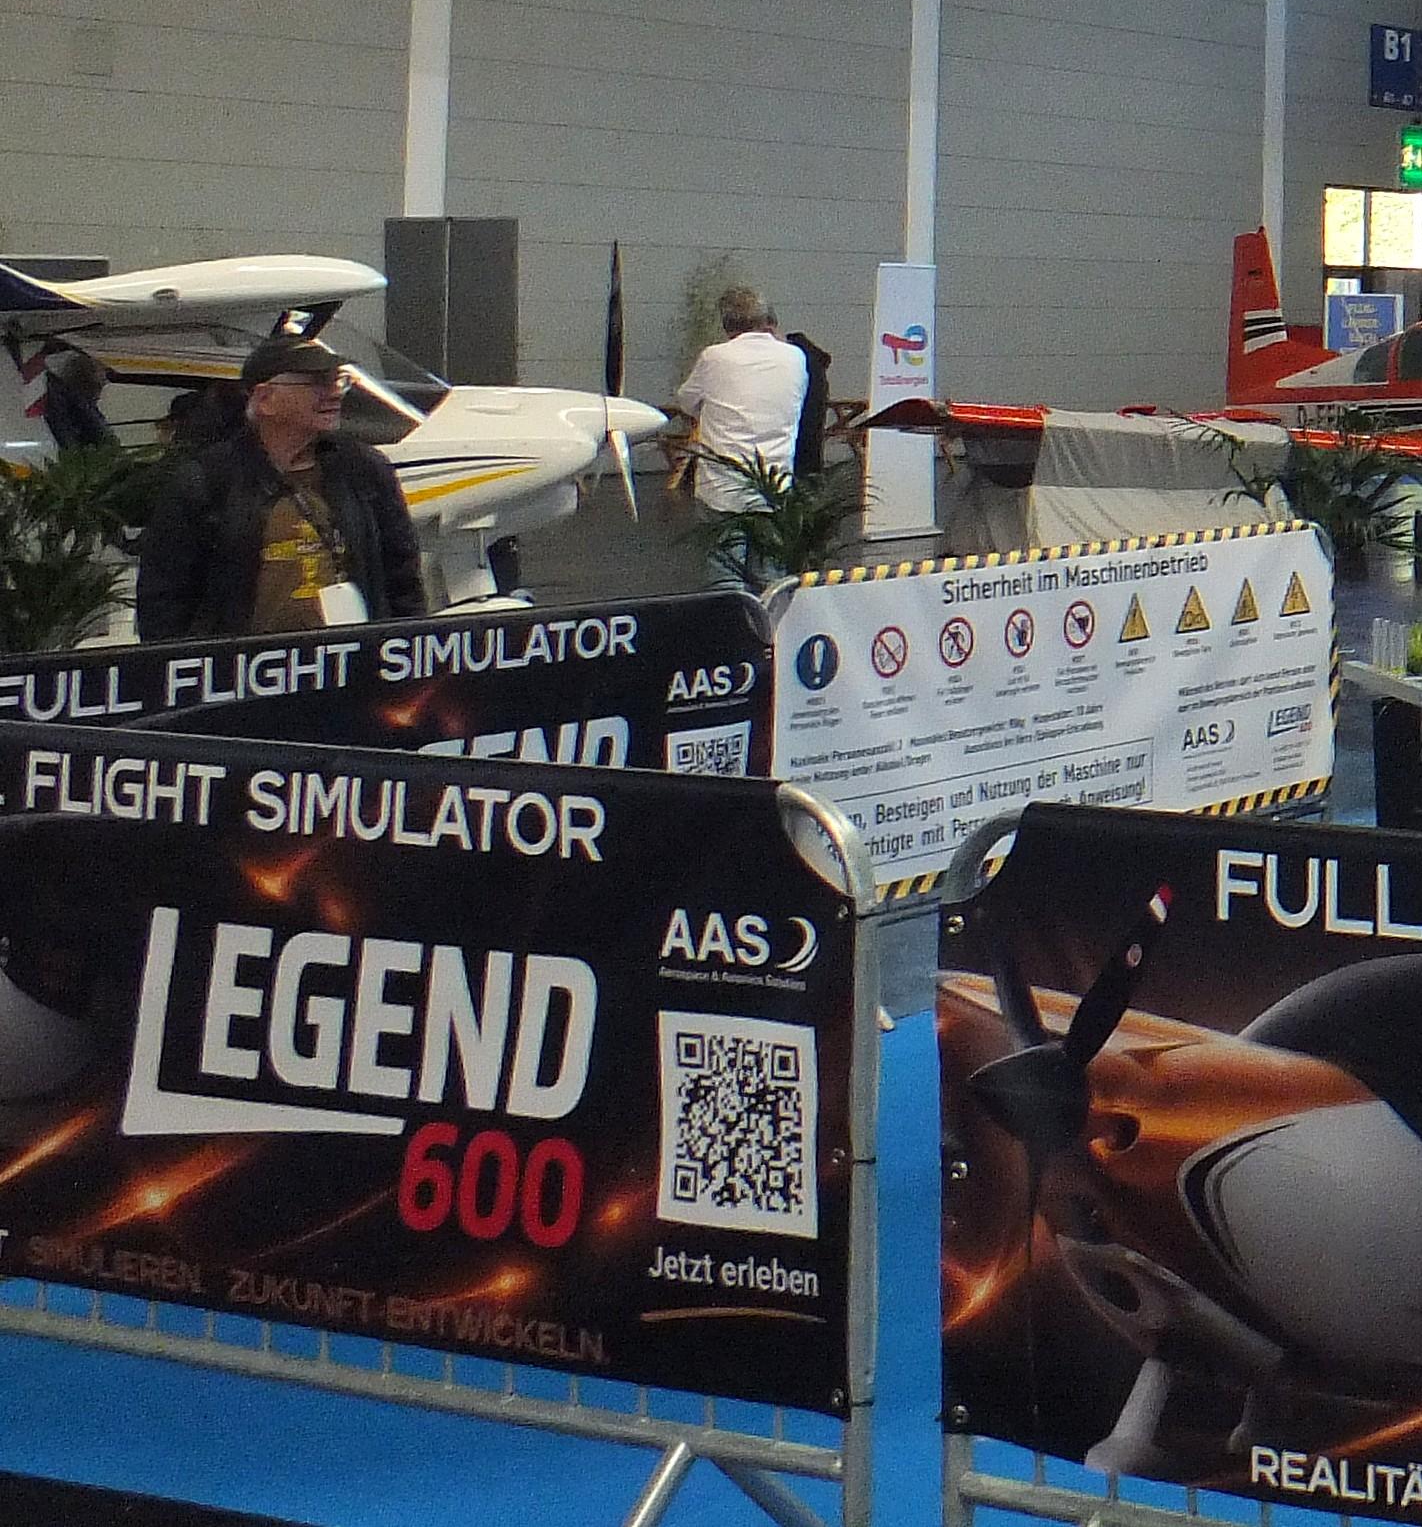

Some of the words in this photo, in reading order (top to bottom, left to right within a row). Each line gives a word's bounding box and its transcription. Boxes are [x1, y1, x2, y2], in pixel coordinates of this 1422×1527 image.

[1384, 29, 1411, 63] B1
[943, 573, 1033, 605] Sicherheit
[1039, 569, 1059, 593] im
[1066, 551, 1209, 588] Maschinenbetrieb
[166, 642, 360, 707] FLIGHT
[380, 614, 637, 681] SIMULATOR
[667, 665, 732, 702] AAS
[1182, 723, 1220, 751] AAS
[25, 750, 226, 826] FLIGHT
[246, 770, 605, 862] SIMULATOR
[875, 794, 945, 825] Besteigen
[952, 784, 973, 809] und
[980, 776, 1032, 802] Nutzung
[1037, 769, 1058, 790] der
[1064, 755, 1122, 783] Maschine
[1127, 753, 1147, 769] nur
[922, 824, 945, 847] mit
[660, 908, 771, 967] AAS
[121, 905, 600, 1136] LEGEND
[398, 1121, 586, 1248] 600
[226, 1268, 375, 1324] ZUKUNFT
[649, 1246, 714, 1285] Jetzt
[721, 1255, 820, 1297] erleben
